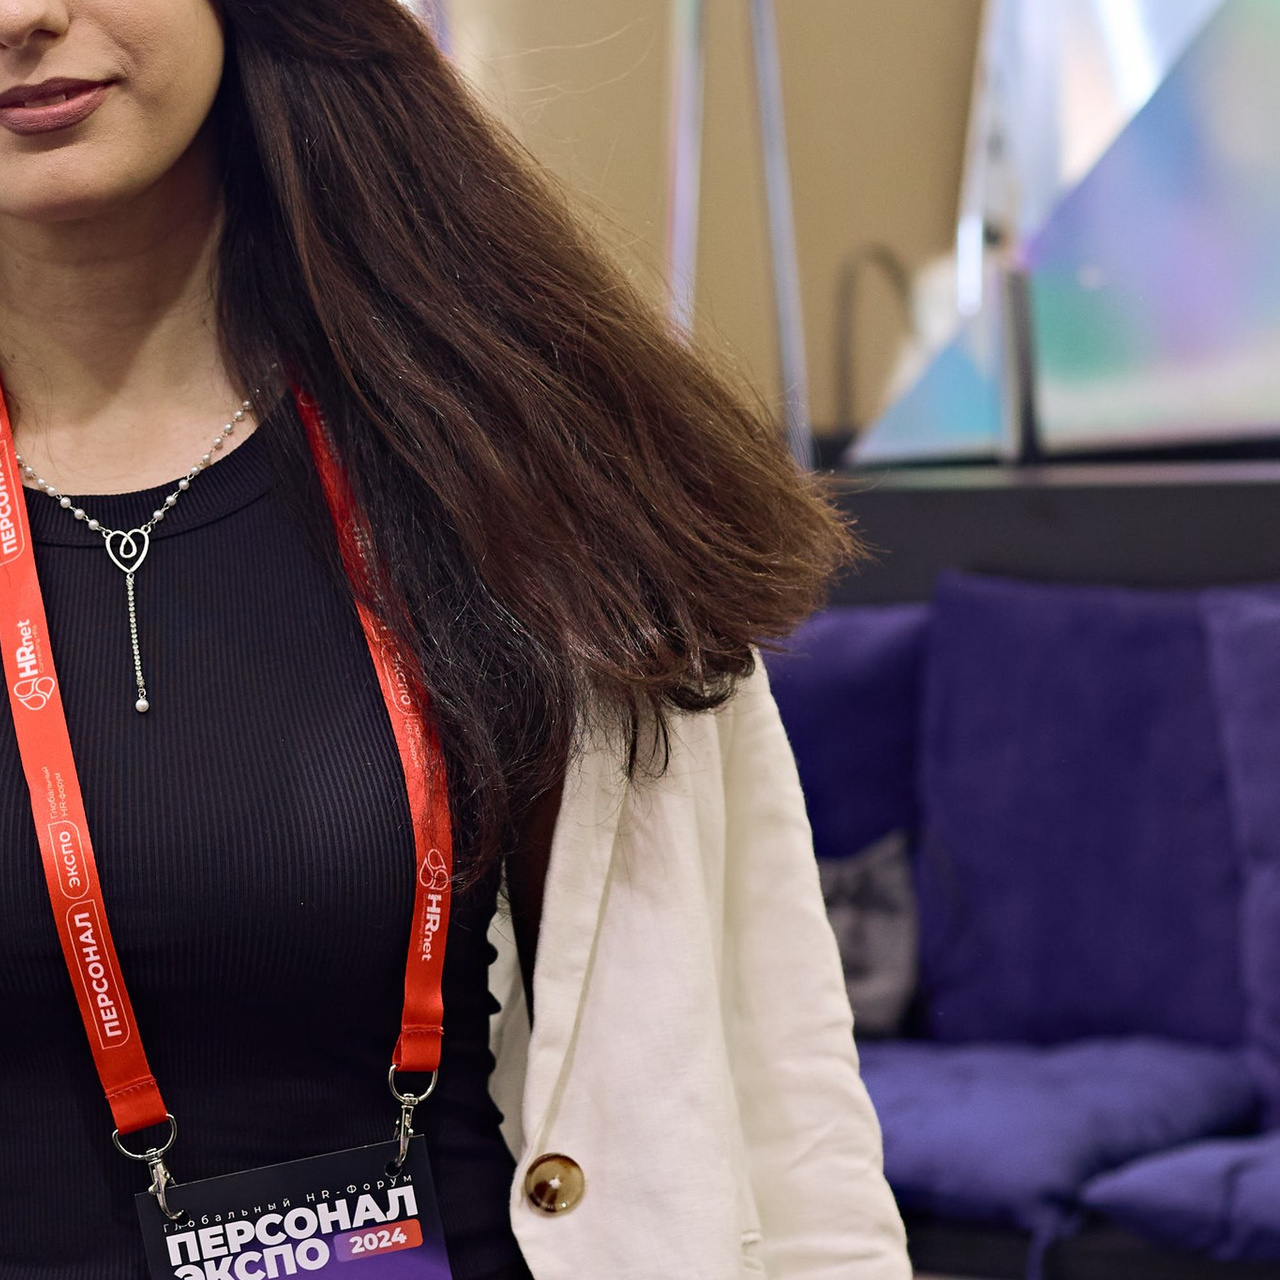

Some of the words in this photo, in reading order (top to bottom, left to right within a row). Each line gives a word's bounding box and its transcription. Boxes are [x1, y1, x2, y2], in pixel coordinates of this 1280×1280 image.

[16, 619, 39, 678] HRnet
[41, 766, 56, 819] Глобальный
[59, 830, 80, 888] ЭКСПО
[421, 894, 442, 961] HRnet
[74, 912, 122, 1038] ПЕРСОНАЛ
[306, 1174, 413, 1203] HR-Форум
[166, 1185, 419, 1266] ПЕРСОНАЛ
[349, 1227, 407, 1254] 2024
